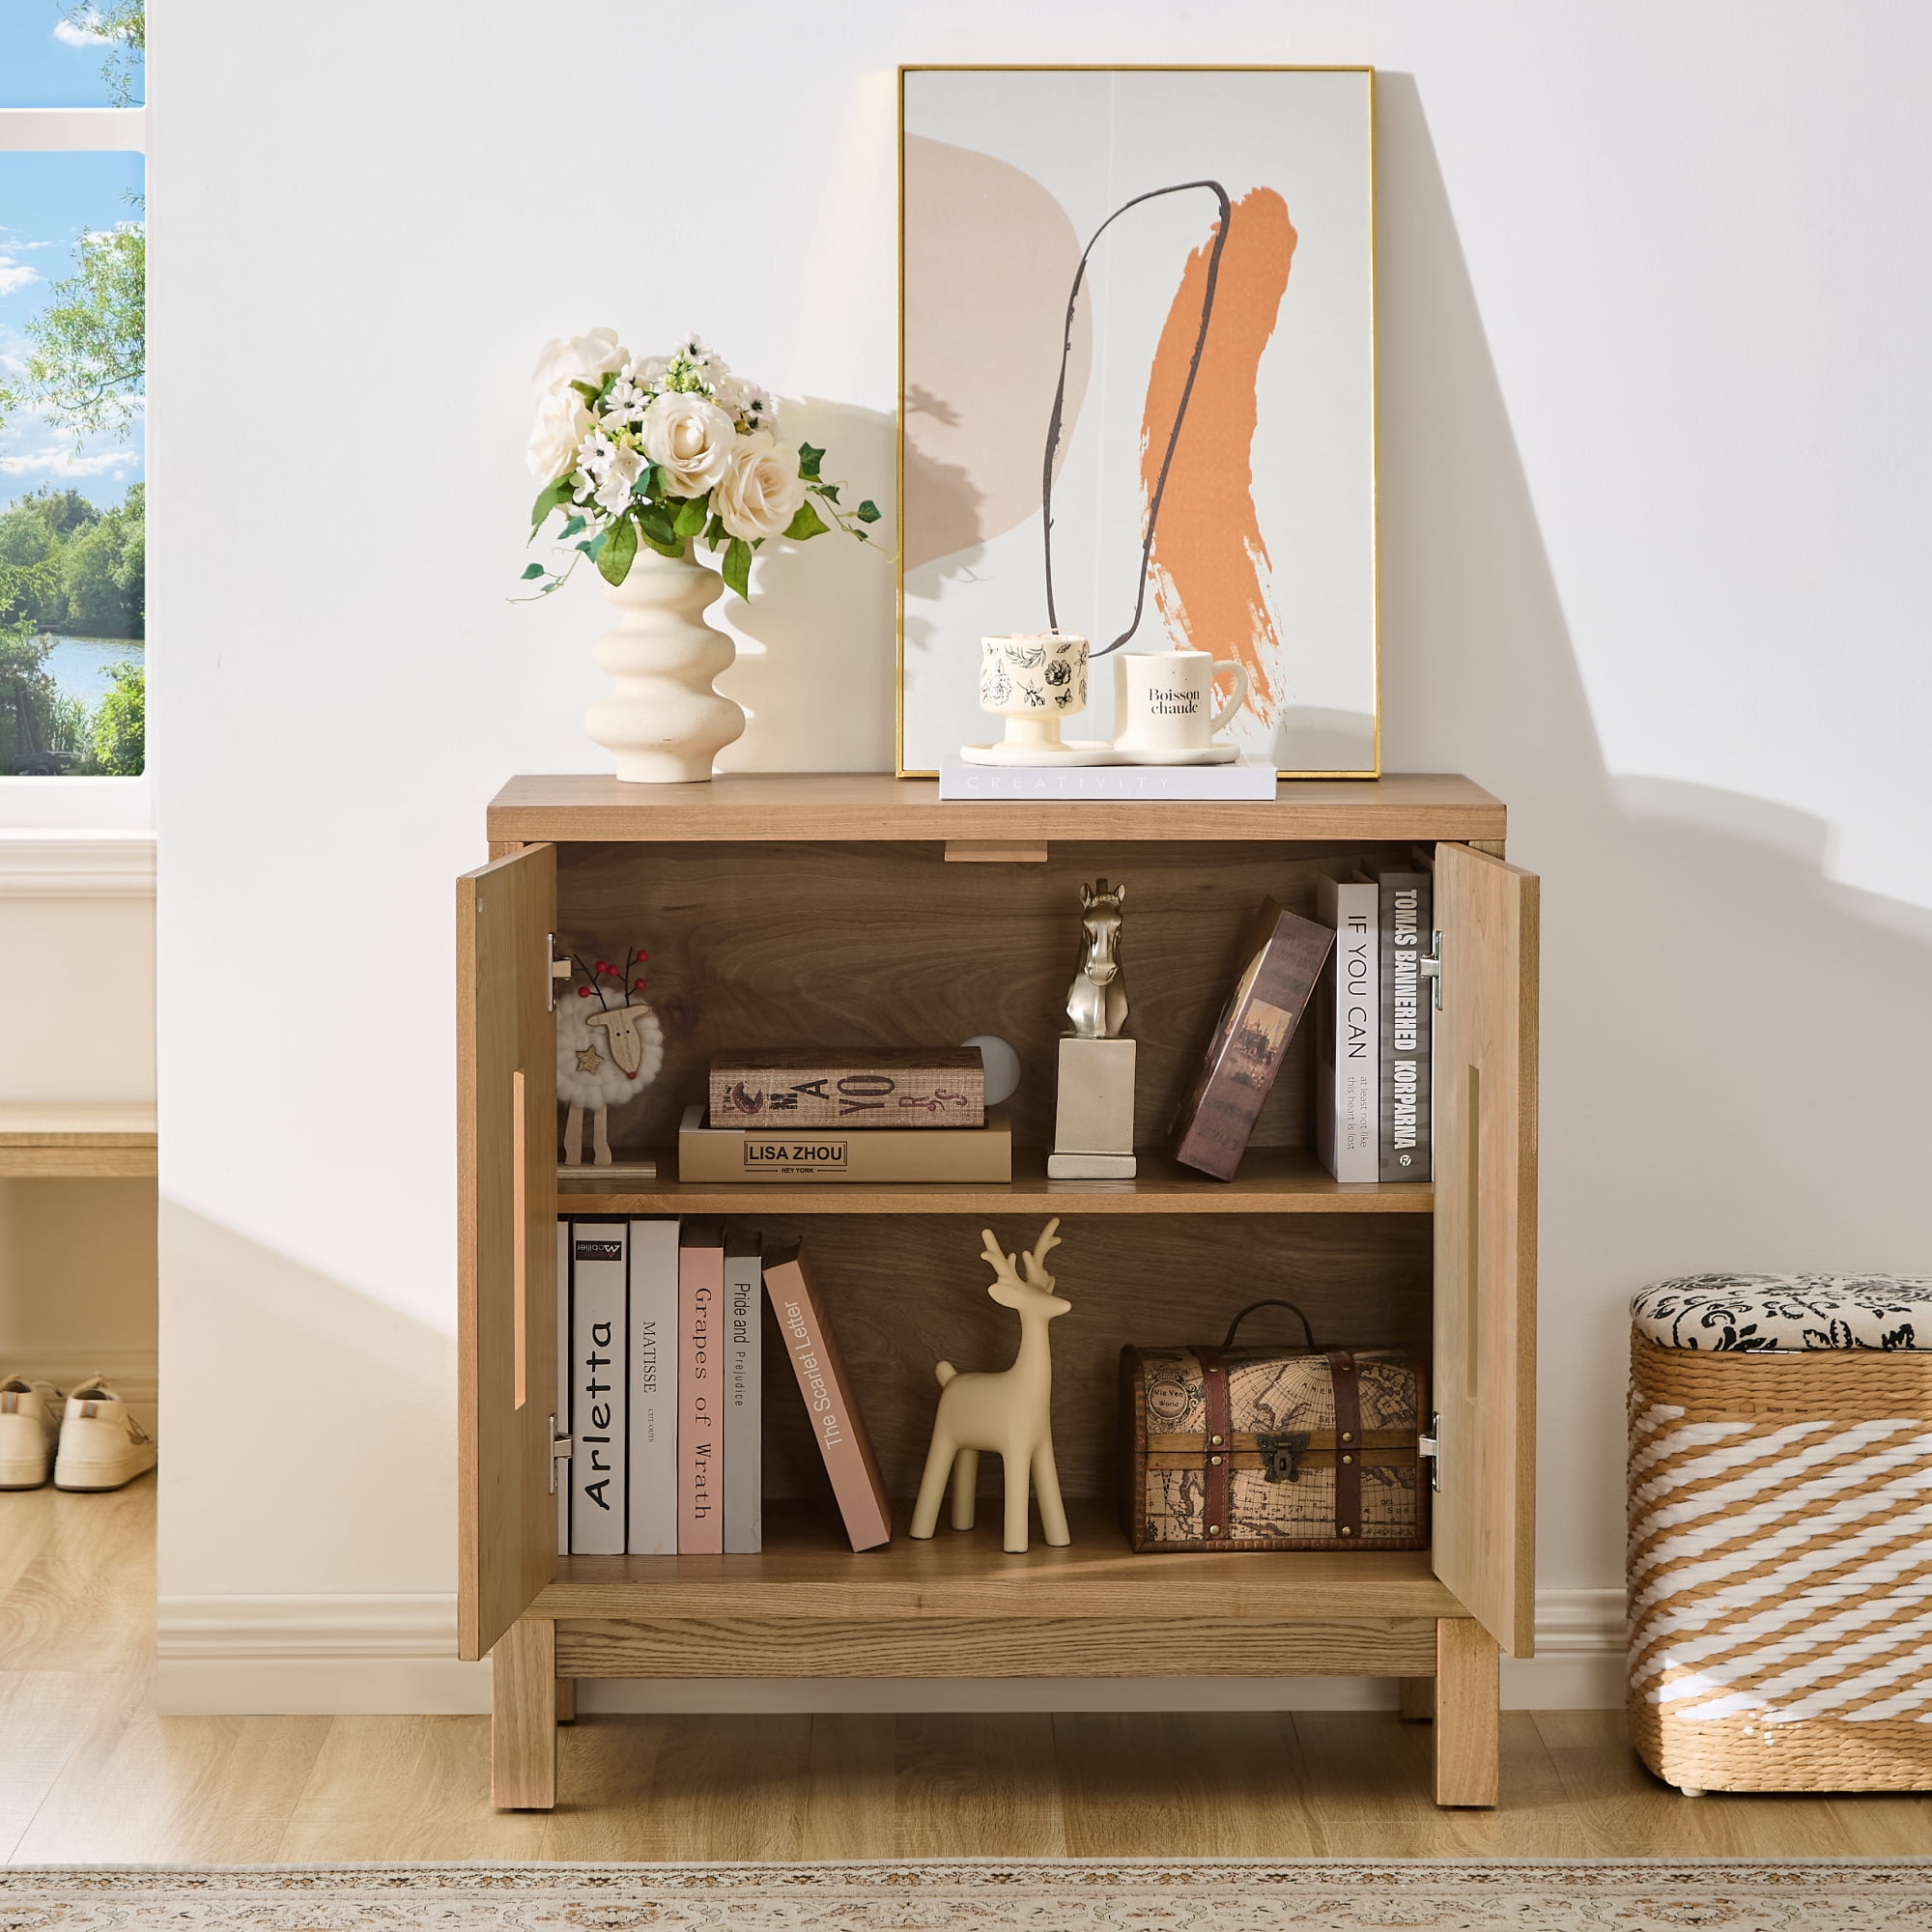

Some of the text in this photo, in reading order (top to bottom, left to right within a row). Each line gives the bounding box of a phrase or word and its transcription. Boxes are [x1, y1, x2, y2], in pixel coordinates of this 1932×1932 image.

[1149, 688, 1200, 702] Boisson
[1151, 700, 1199, 715] chaude
[966, 777, 1169, 789] CREATIVITY
[1348, 916, 1367, 1059] IF YOU CAN
[1394, 889, 1417, 1150] TOMAS BANNERHED KORPARNA
[1348, 1076, 1356, 1094] this
[1348, 1096, 1356, 1120] heart
[749, 1146, 842, 1160] LISA ZHOU
[1348, 1133, 1356, 1150] lost
[642, 1321, 656, 1393] MATISSE
[733, 1283, 751, 1406] Pride and Prejudice
[784, 1301, 842, 1450] The Scarlet Letter
[582, 1321, 611, 1511] Arletta
[693, 1288, 712, 1520] Grapes of Wrath
